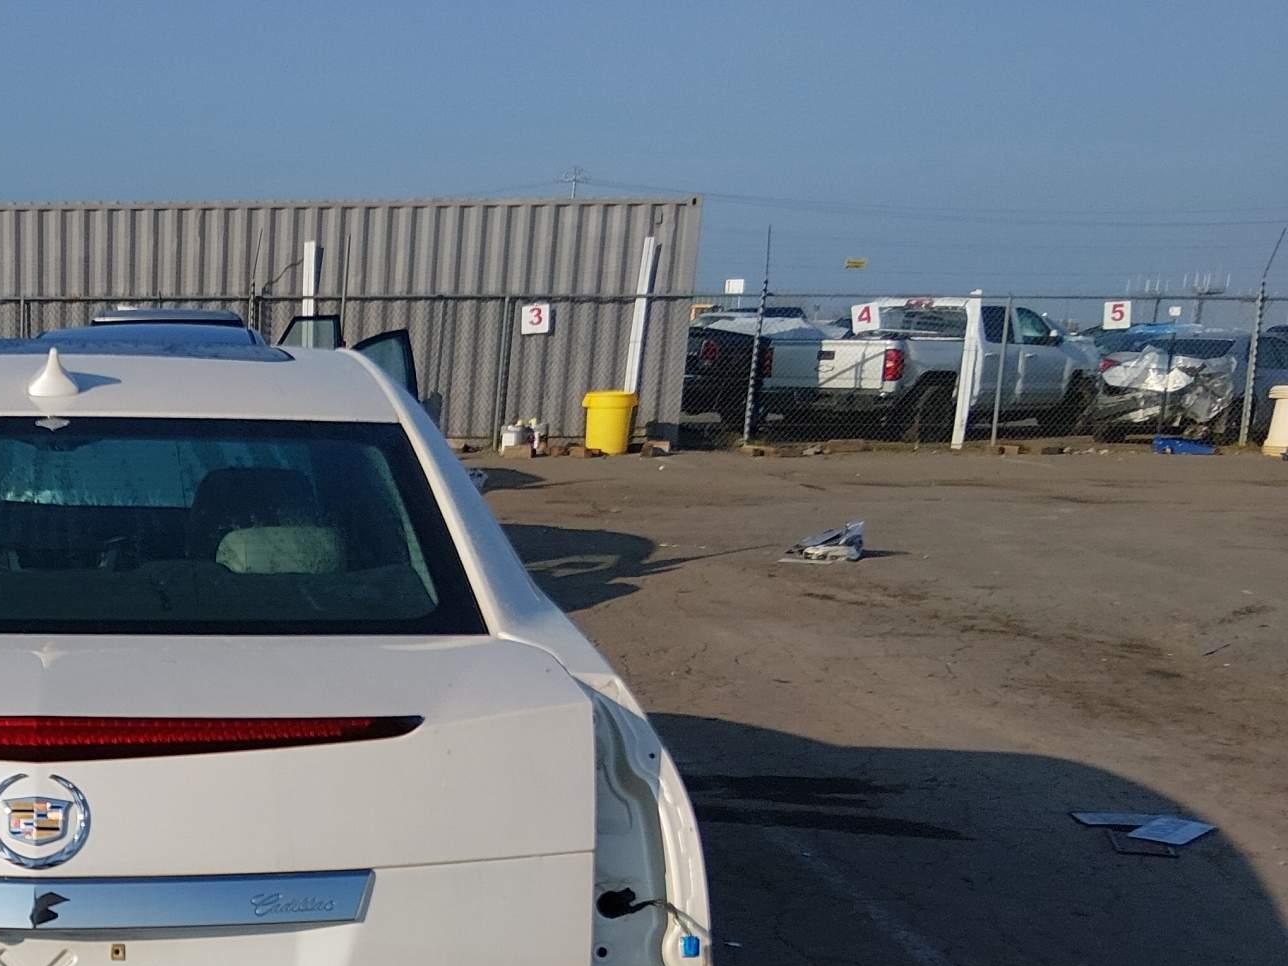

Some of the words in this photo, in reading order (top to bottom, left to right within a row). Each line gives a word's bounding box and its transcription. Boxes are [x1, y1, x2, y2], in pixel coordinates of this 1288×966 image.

[528, 307, 543, 326] 3
[857, 305, 871, 324] 4
[1111, 303, 1125, 321] 5
